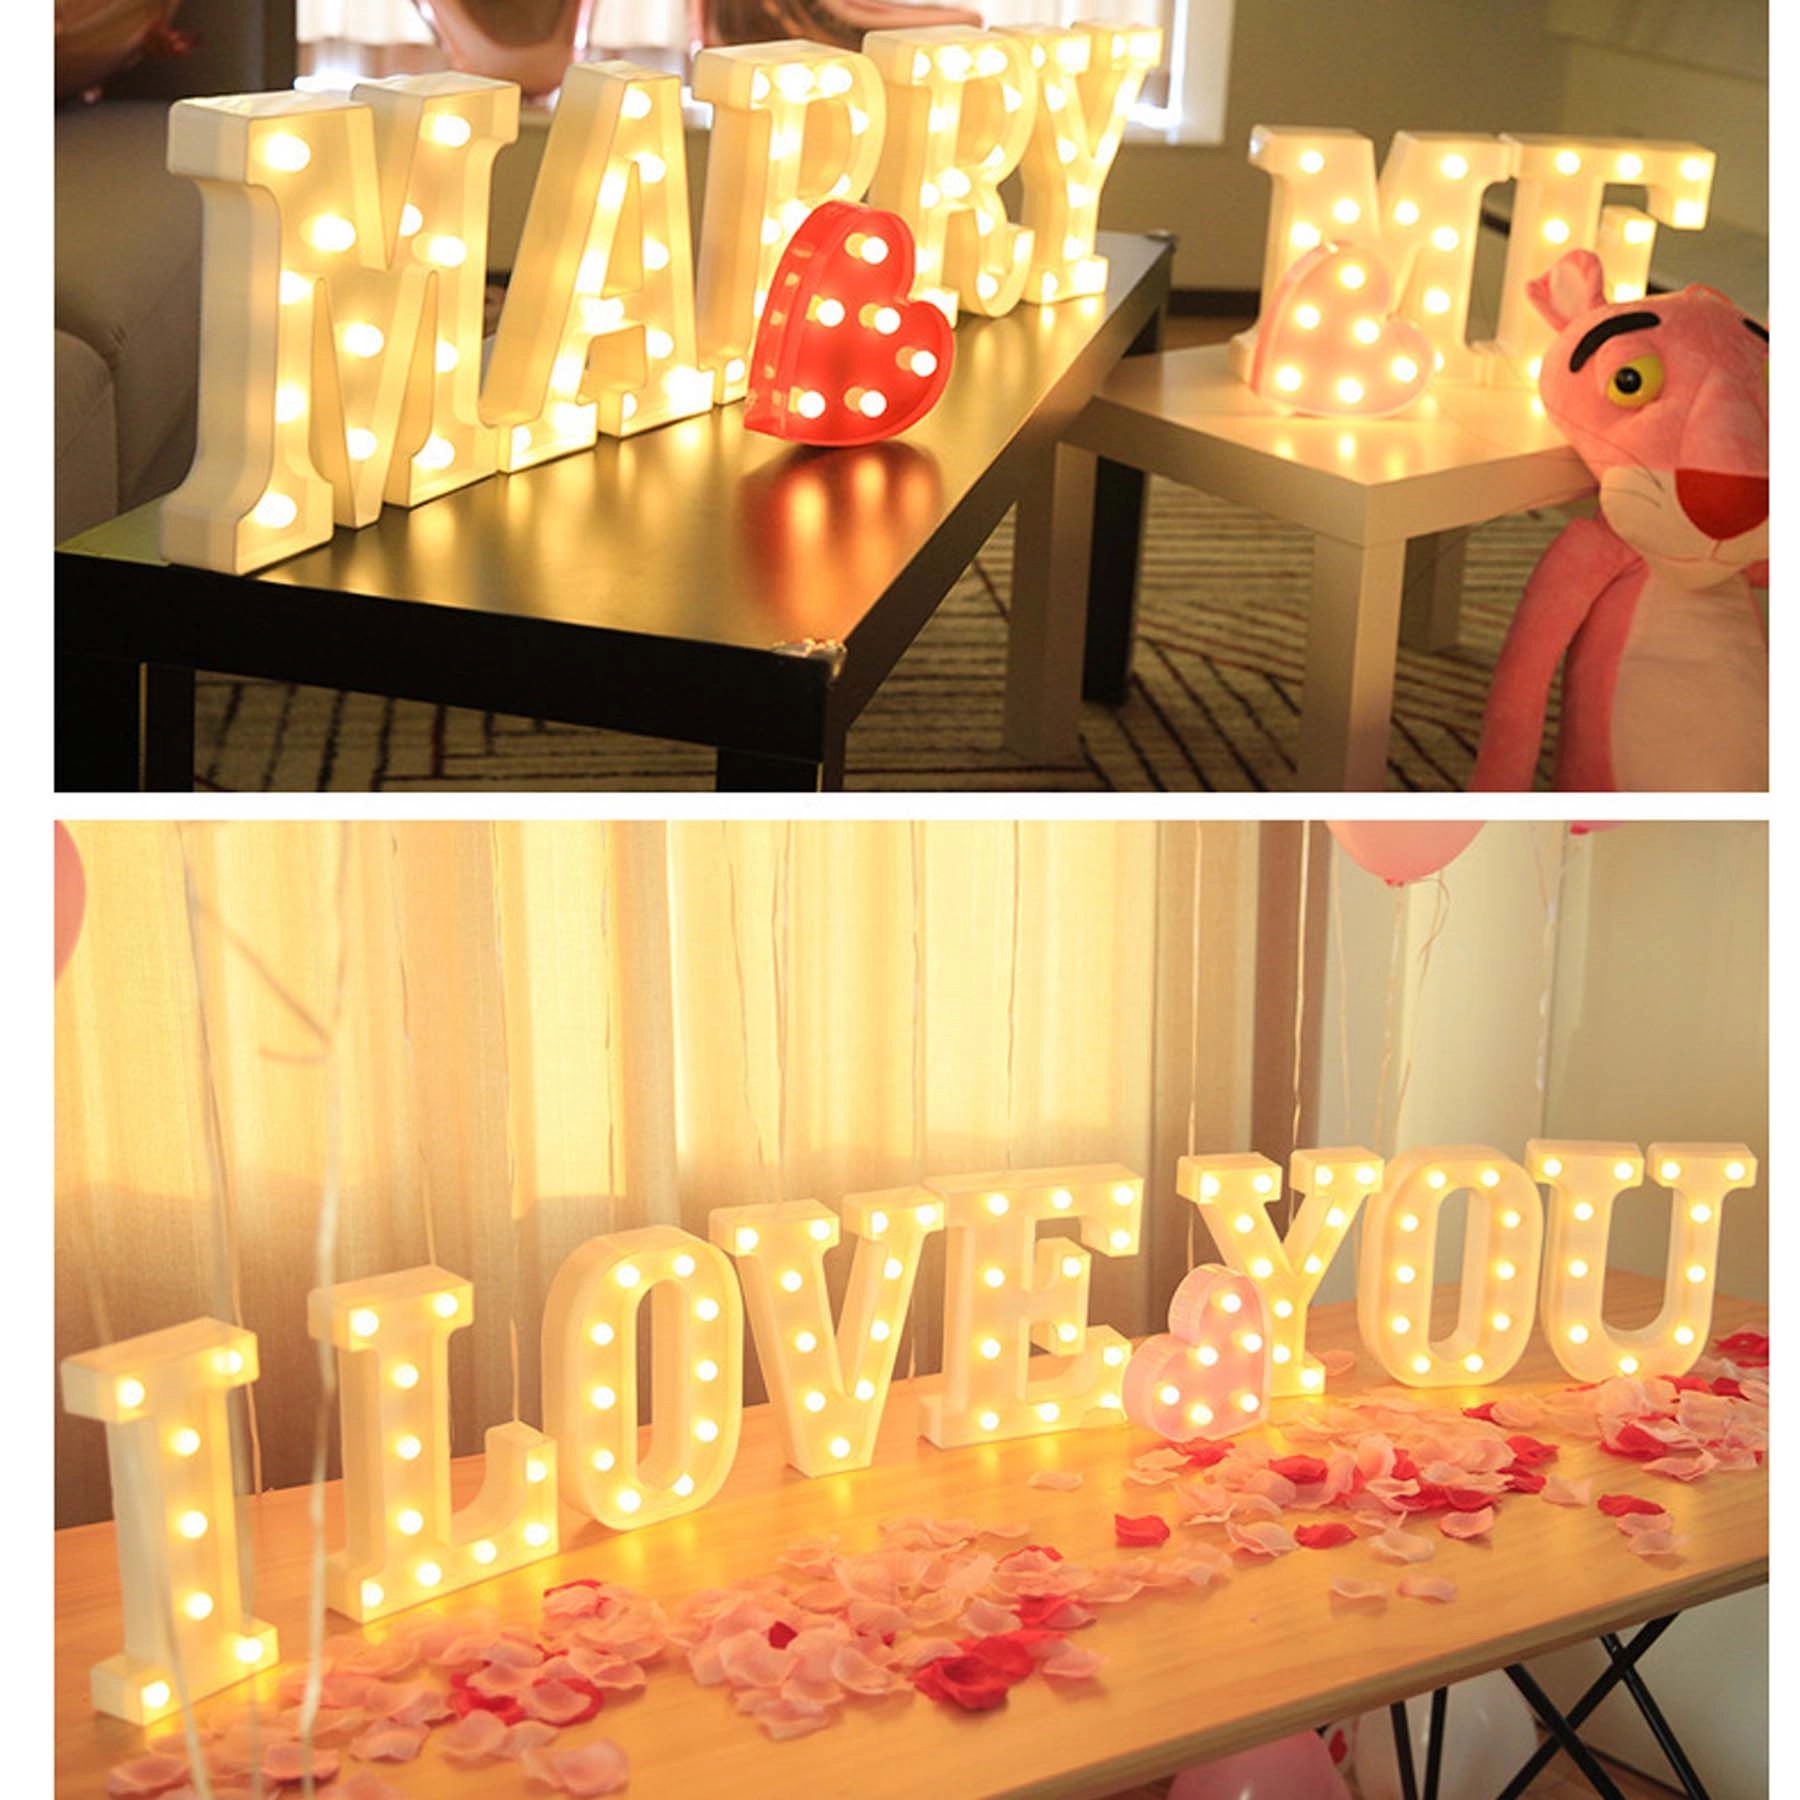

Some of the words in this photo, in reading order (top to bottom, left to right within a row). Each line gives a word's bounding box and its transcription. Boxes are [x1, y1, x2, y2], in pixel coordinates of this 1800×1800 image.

[161, 22, 1162, 574] MARRY
[1229, 125, 1716, 390] ME
[61, 1317, 279, 1725] I
[308, 1164, 1144, 1623] LOVE
[1176, 1139, 1758, 1397] YOU
